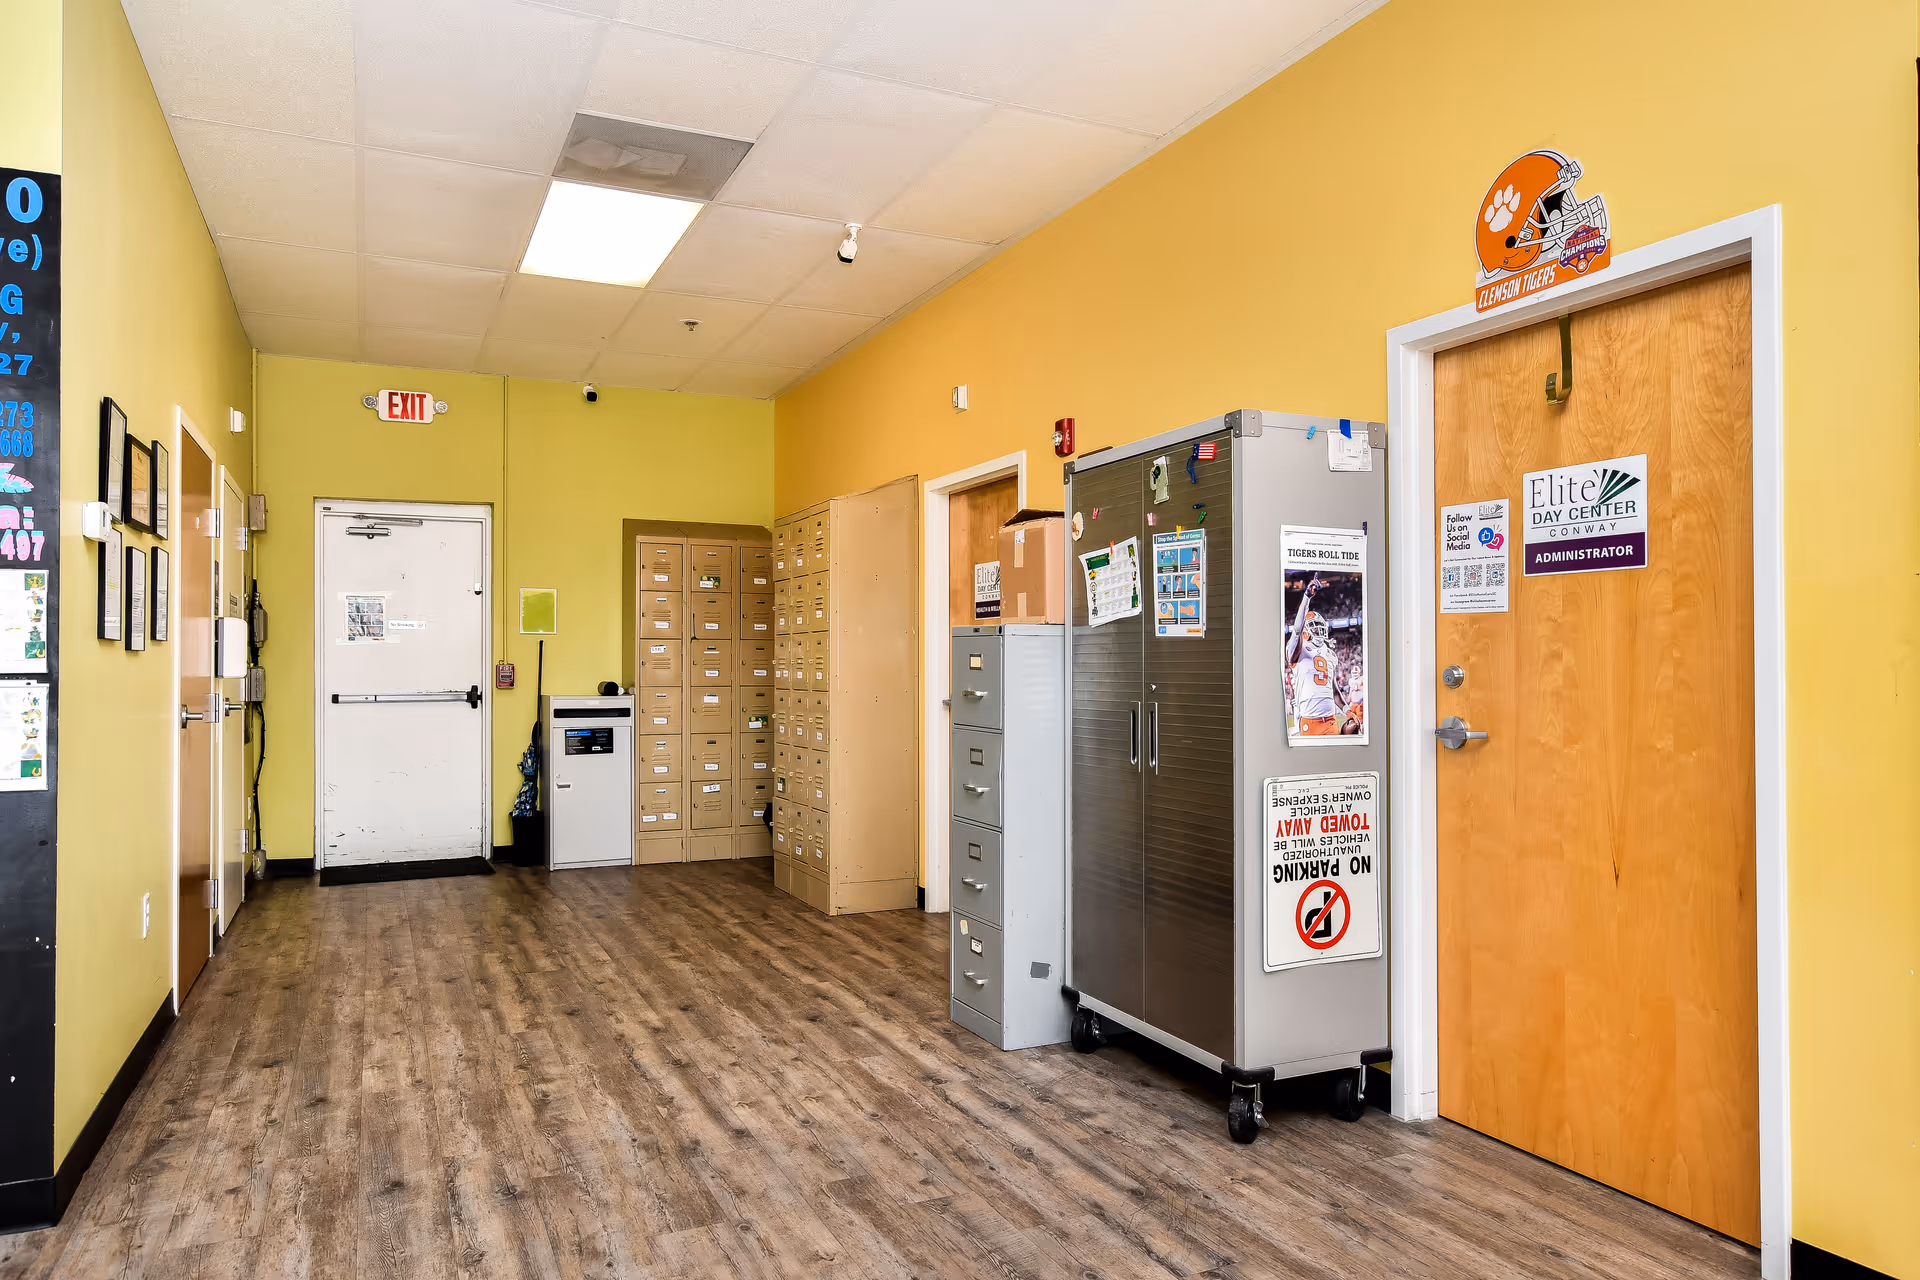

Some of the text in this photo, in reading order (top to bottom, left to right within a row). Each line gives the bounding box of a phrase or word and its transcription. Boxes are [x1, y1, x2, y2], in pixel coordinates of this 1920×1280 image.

[1567, 230, 1598, 247] NATIONAL
[0, 233, 43, 270] e)
[1560, 235, 1605, 262] CHAMPIONS
[1478, 264, 1557, 309] CLEMSON TIGERS
[388, 392, 426, 420] EXIT
[1530, 475, 1595, 509] Elite
[1447, 513, 1472, 523] Follow
[1533, 500, 1636, 525] DAY CENTER
[1447, 524, 1456, 532] Us
[1447, 531, 1469, 542] Social
[1550, 522, 1617, 537] CONWAY
[1288, 549, 1359, 560] TIGERS ROLL TIDE
[1447, 541, 1470, 551] Media
[1536, 545, 1634, 564] ADMINISTRATOR
[977, 566, 995, 585] Elite
[1313, 655, 1328, 686] 9
[1272, 791, 1371, 807] OWNER'S EXPENSE
[1291, 803, 1352, 817] AT VEHICLE
[1276, 813, 1369, 838] TOWED AWAY
[1274, 833, 1370, 851] VEHICLES WILL BE
[1283, 845, 1361, 861] UNAUTHORIZED
[1273, 855, 1371, 883] NO PARKING
